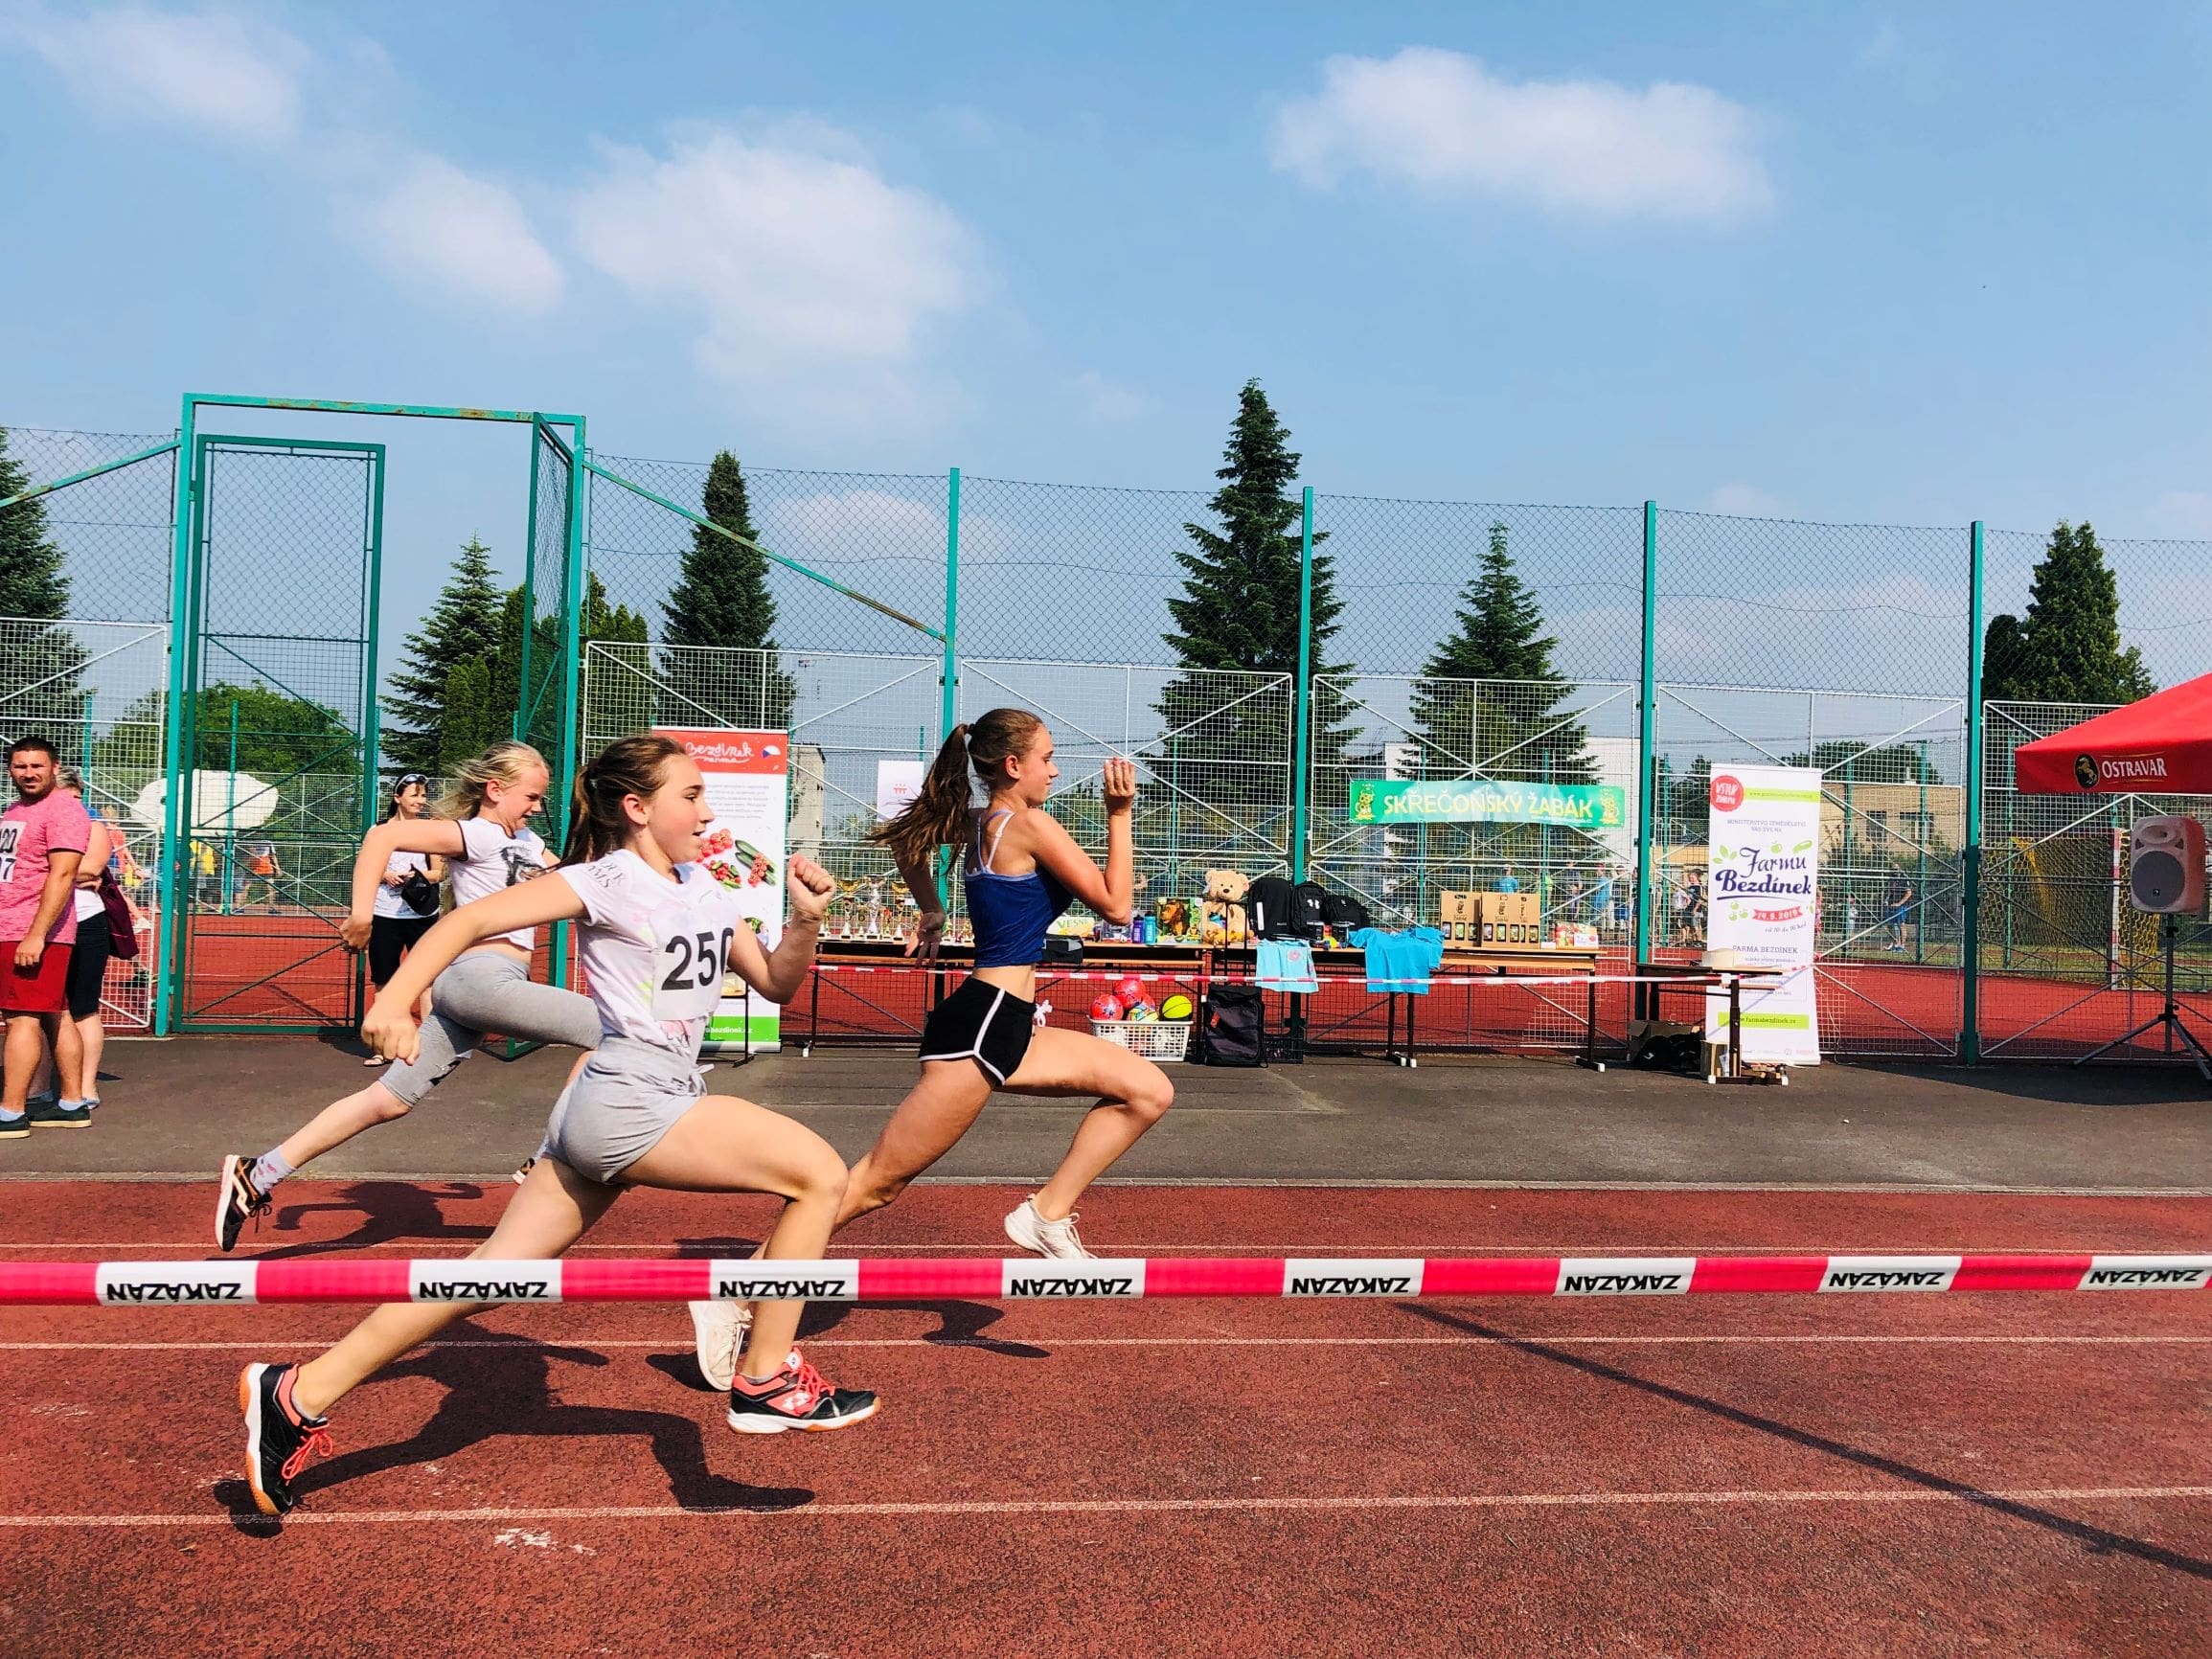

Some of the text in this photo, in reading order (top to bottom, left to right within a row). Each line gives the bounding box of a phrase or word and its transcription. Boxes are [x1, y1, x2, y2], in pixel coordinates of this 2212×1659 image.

[2102, 758, 2168, 779] OSTRAVAR
[1383, 788, 1593, 819] SKŘEČOŇSKÝ ŽABÁK
[1740, 847, 1807, 878] Farmu
[1715, 869, 1813, 895] Bezdínek
[661, 927, 735, 991] 250
[1010, 1278, 1133, 1297] ZAKÁZÁN
[1290, 1277, 1411, 1295] ZAKÁZÁN
[1563, 1274, 1682, 1293] ZAKÁZÁN
[1828, 1270, 1946, 1290] ZAKÁZÁN
[2088, 1268, 2204, 1288] ZAKÁZÁN
[106, 1282, 242, 1303] ZAKÁZÁN
[418, 1281, 549, 1301] ZAKÁZÁN
[718, 1280, 846, 1299] ZAKÁZÁN
